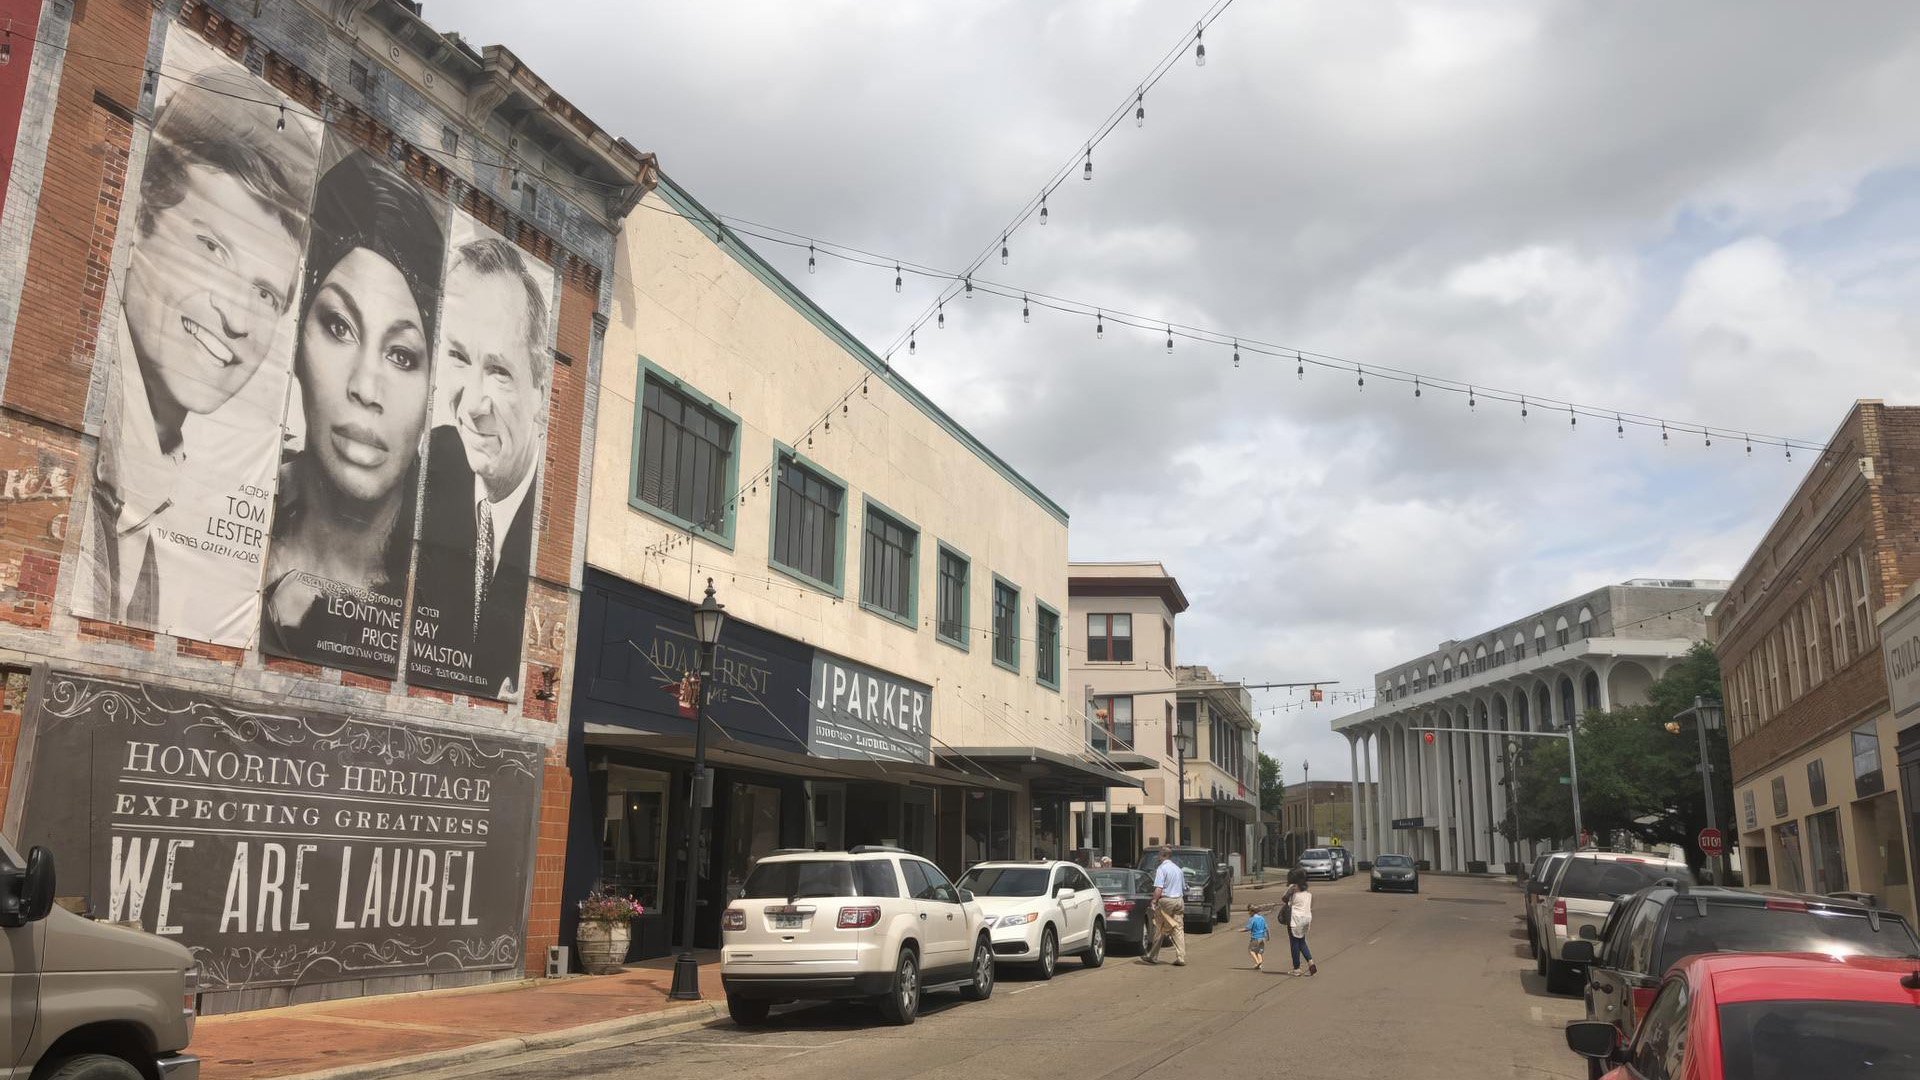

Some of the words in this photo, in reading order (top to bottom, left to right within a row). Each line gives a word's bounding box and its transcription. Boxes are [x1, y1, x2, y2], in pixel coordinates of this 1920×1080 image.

[226, 496, 265, 524] TOM
[207, 517, 262, 548] LESTER
[327, 596, 401, 629] LEONTYNE
[361, 627, 398, 651] PRICE
[415, 620, 439, 640] RAY
[413, 641, 473, 669] WALSTON
[123, 741, 329, 788] HONORING
[340, 765, 491, 802] HERITAGE
[112, 793, 320, 826] EXPECTING
[335, 809, 490, 836] GREATNESS
[109, 836, 195, 934] WE
[219, 841, 318, 933] ARE
[336, 846, 479, 930] LAUREL
